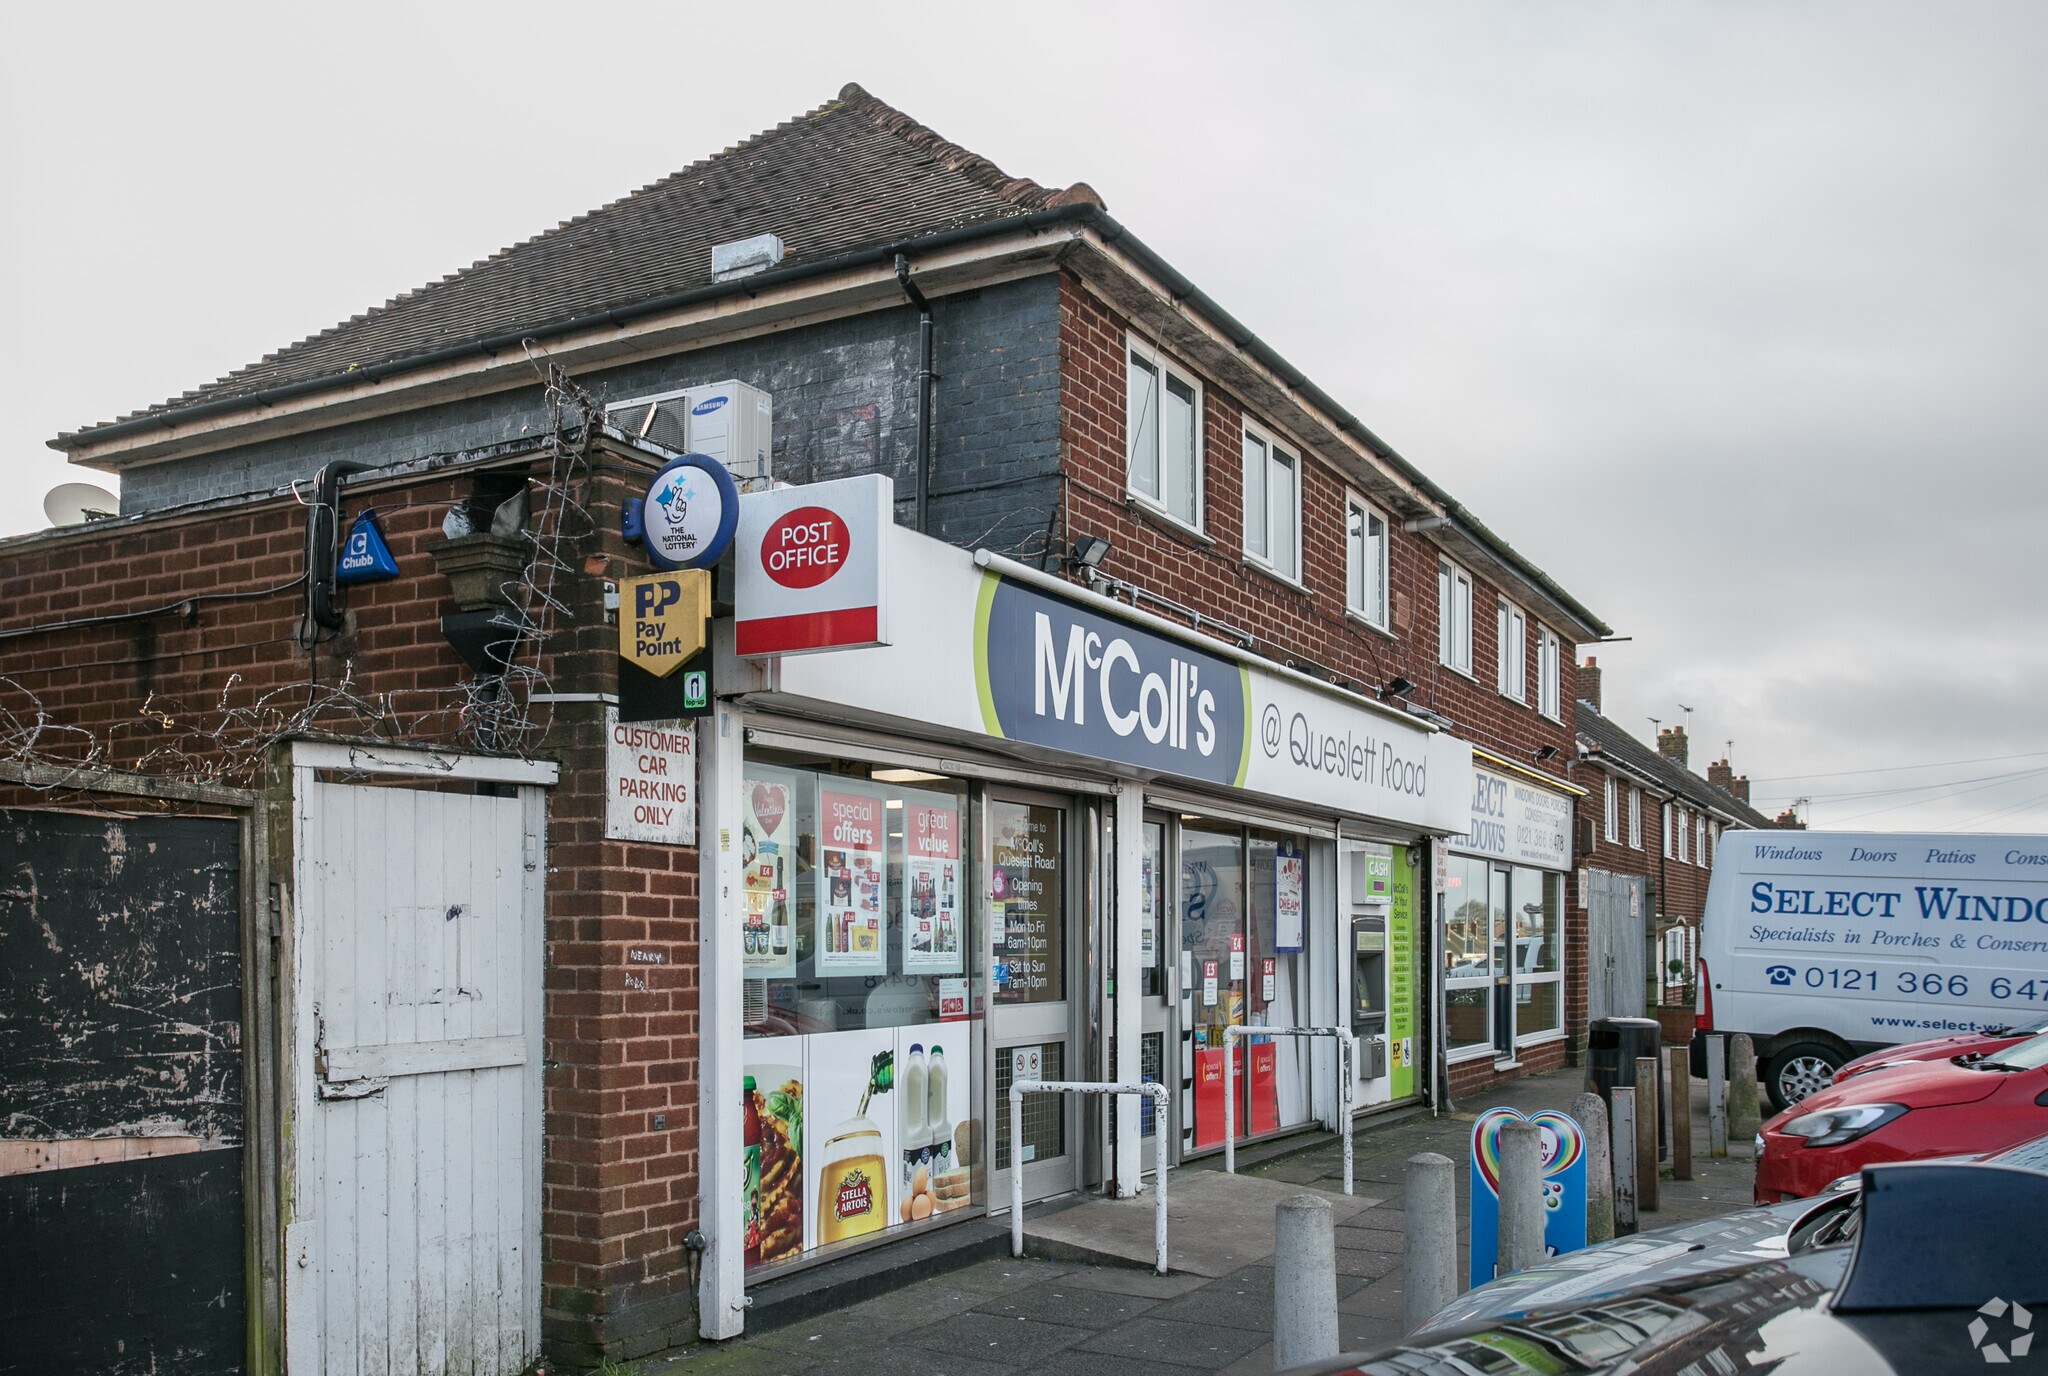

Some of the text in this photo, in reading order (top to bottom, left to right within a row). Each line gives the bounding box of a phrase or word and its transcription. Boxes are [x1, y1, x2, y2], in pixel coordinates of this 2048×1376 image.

[696, 400, 725, 411] SAMSUNG
[662, 533, 697, 543] NATIONAL
[781, 521, 832, 546] POST
[665, 541, 696, 550] LOTTERY
[342, 554, 374, 569] Chubb
[769, 544, 839, 571] OFFICE
[636, 620, 666, 638] Pay
[636, 637, 681, 658] Point
[1034, 611, 1216, 758] McColl's
[614, 725, 690, 755] CUSTOMER
[1260, 702, 1427, 798] @ Queslett Road
[638, 754, 667, 776] CAR
[619, 777, 687, 803] PARKING
[634, 805, 673, 826] ONLY
[832, 802, 873, 822] special
[917, 811, 949, 833] great
[1039, 823, 1047, 833] to
[833, 820, 873, 845] offers
[1517, 825, 1531, 844] 0121
[1534, 829, 1547, 847] 366
[918, 837, 949, 854] value
[998, 851, 1056, 870] Queslett Road
[1754, 845, 1823, 862] Windows
[1850, 847, 1898, 863] Doors
[1925, 849, 1976, 864] Patios
[1368, 861, 1388, 877] CASH
[1012, 878, 1043, 894] Opening
[1017, 899, 1038, 911] times
[1278, 897, 1300, 911] DREAM
[1751, 881, 1901, 918] SELECT
[1393, 909, 1408, 919] Service
[1010, 920, 1045, 933] Mon to Fri
[1007, 936, 1047, 951] 6am-10pm
[1233, 937, 1241, 950] £4
[1750, 925, 1835, 943] Specialists
[1844, 929, 1861, 944] in
[1871, 930, 1940, 947] Porches
[1950, 934, 1966, 949] &
[630, 949, 662, 964] NEARY
[1009, 960, 1046, 973] Sat to Sun
[1206, 962, 1215, 977] £3
[1265, 961, 1273, 974] £4
[1008, 976, 1047, 991] 7am-10pm
[1805, 967, 1877, 991] 0121
[1897, 972, 1968, 996] 366
[1205, 1071, 1219, 1081] offers
[1260, 1064, 1271, 1072] offers
[841, 1187, 867, 1202] STELLA
[841, 1198, 868, 1214] ARTOIS
